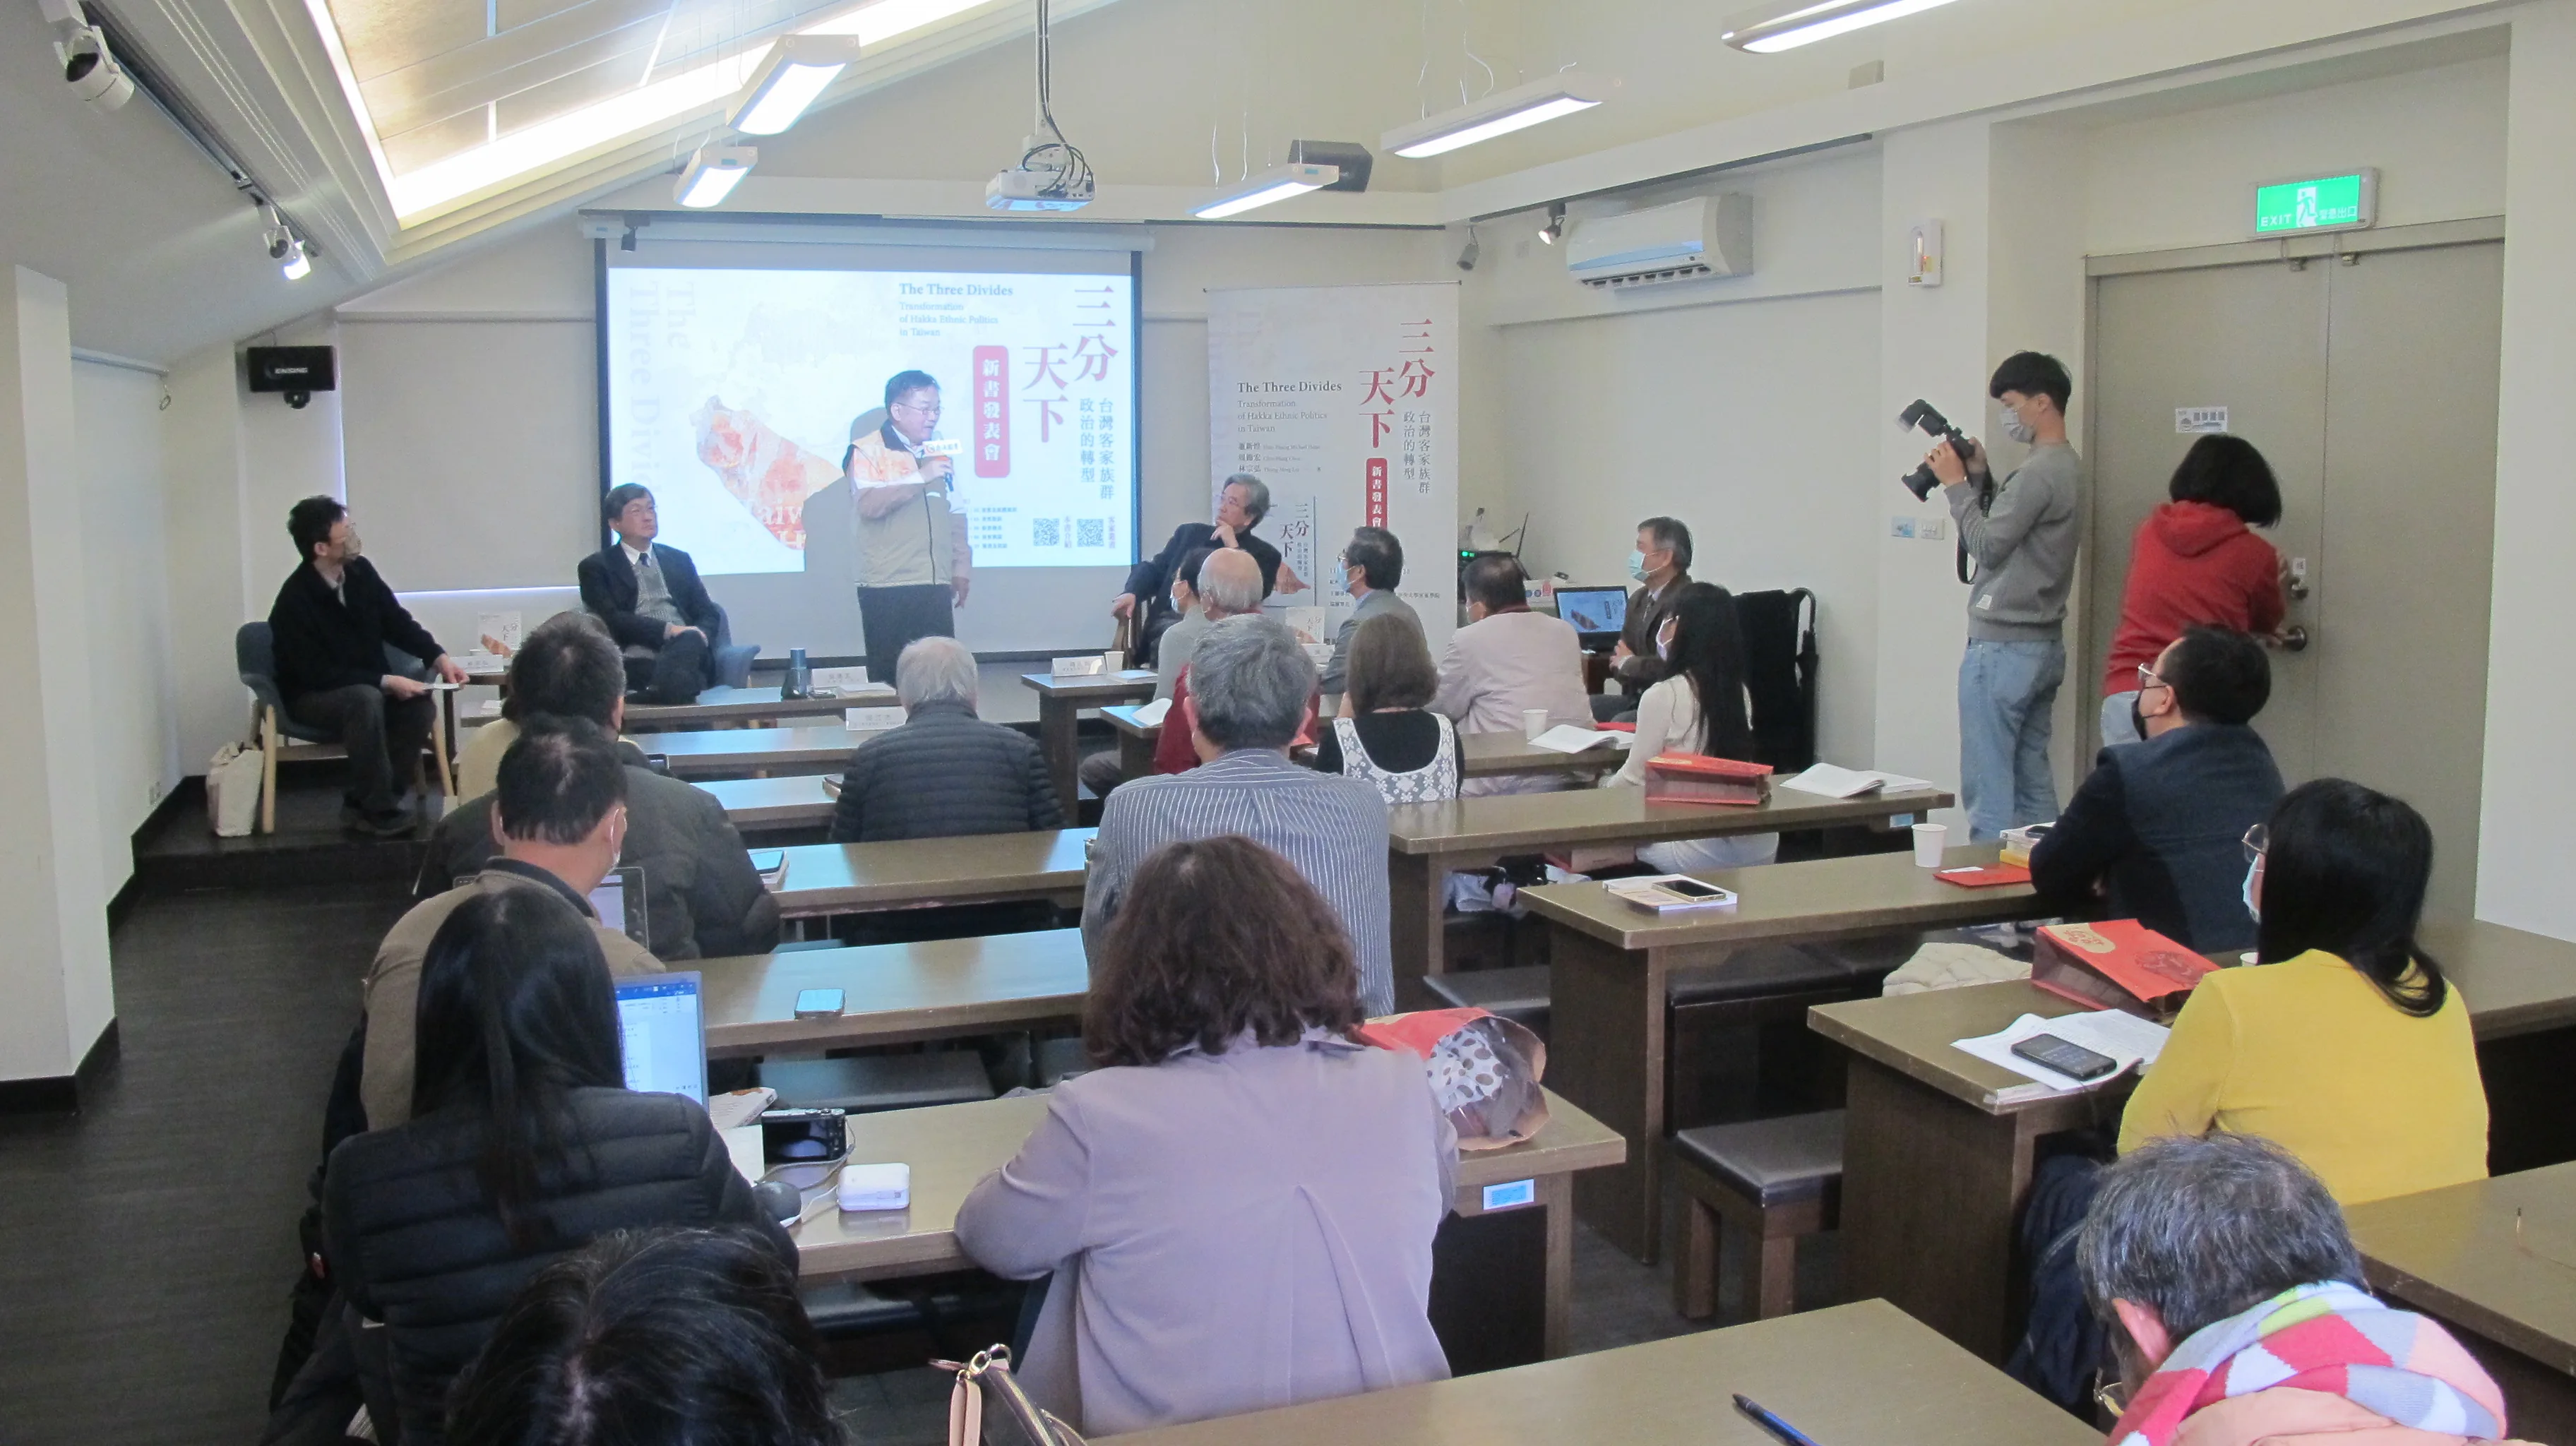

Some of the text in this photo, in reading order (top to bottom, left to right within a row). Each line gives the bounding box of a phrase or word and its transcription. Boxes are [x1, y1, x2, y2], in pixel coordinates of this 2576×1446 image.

[2261, 214, 2291, 227] EXIT
[900, 284, 1013, 296] The Three Divides
[900, 302, 964, 311] Transformation
[900, 315, 998, 324] of Hakka Ethnic Politics
[900, 328, 941, 336] in Taiwan
[1072, 285, 1119, 382] 三分
[1399, 318, 1436, 398] 三分
[982, 359, 1001, 461] 新書發表會
[1022, 342, 1069, 443] 天下
[1237, 381, 1342, 393] The Three Divides
[1359, 367, 1395, 448] 天下
[1080, 398, 1095, 483] 政治的轉型
[1099, 398, 1115, 499] 台灣客家族群
[1403, 411, 1415, 480] 政治的轉型
[1418, 411, 1431, 494] 台灣客家族群
[1294, 503, 1309, 537] 三分
[1372, 466, 1383, 527] 新書發表會
[1280, 523, 1294, 558] 天下
